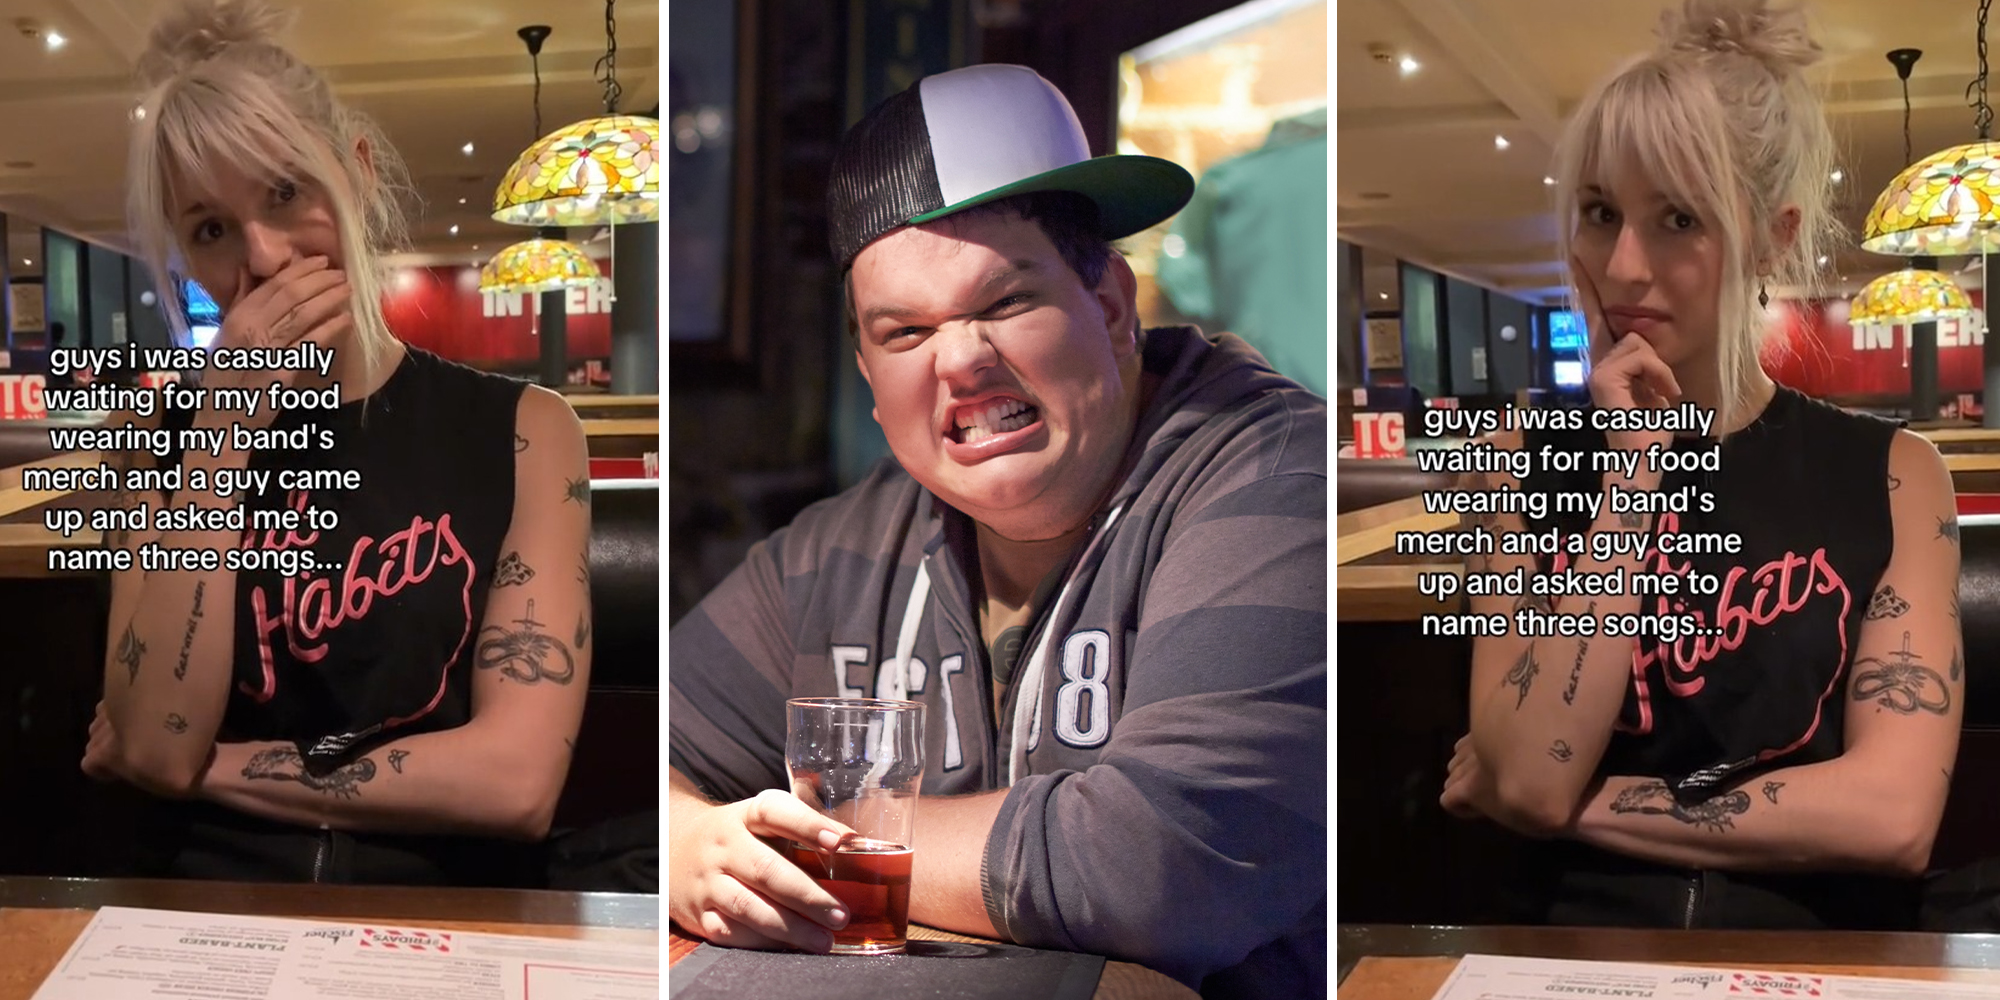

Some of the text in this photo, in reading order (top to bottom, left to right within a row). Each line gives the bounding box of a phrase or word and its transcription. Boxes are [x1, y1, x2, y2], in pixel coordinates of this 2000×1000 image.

[0, 374, 47, 413] TG
[1352, 412, 1406, 452] TG
[178, 937, 287, 952] PLANT-BASED
[373, 934, 432, 945] FRIDAYS
[1544, 984, 1655, 998] PLANT-BASED
[1741, 979, 1803, 990] FRIDAYS
